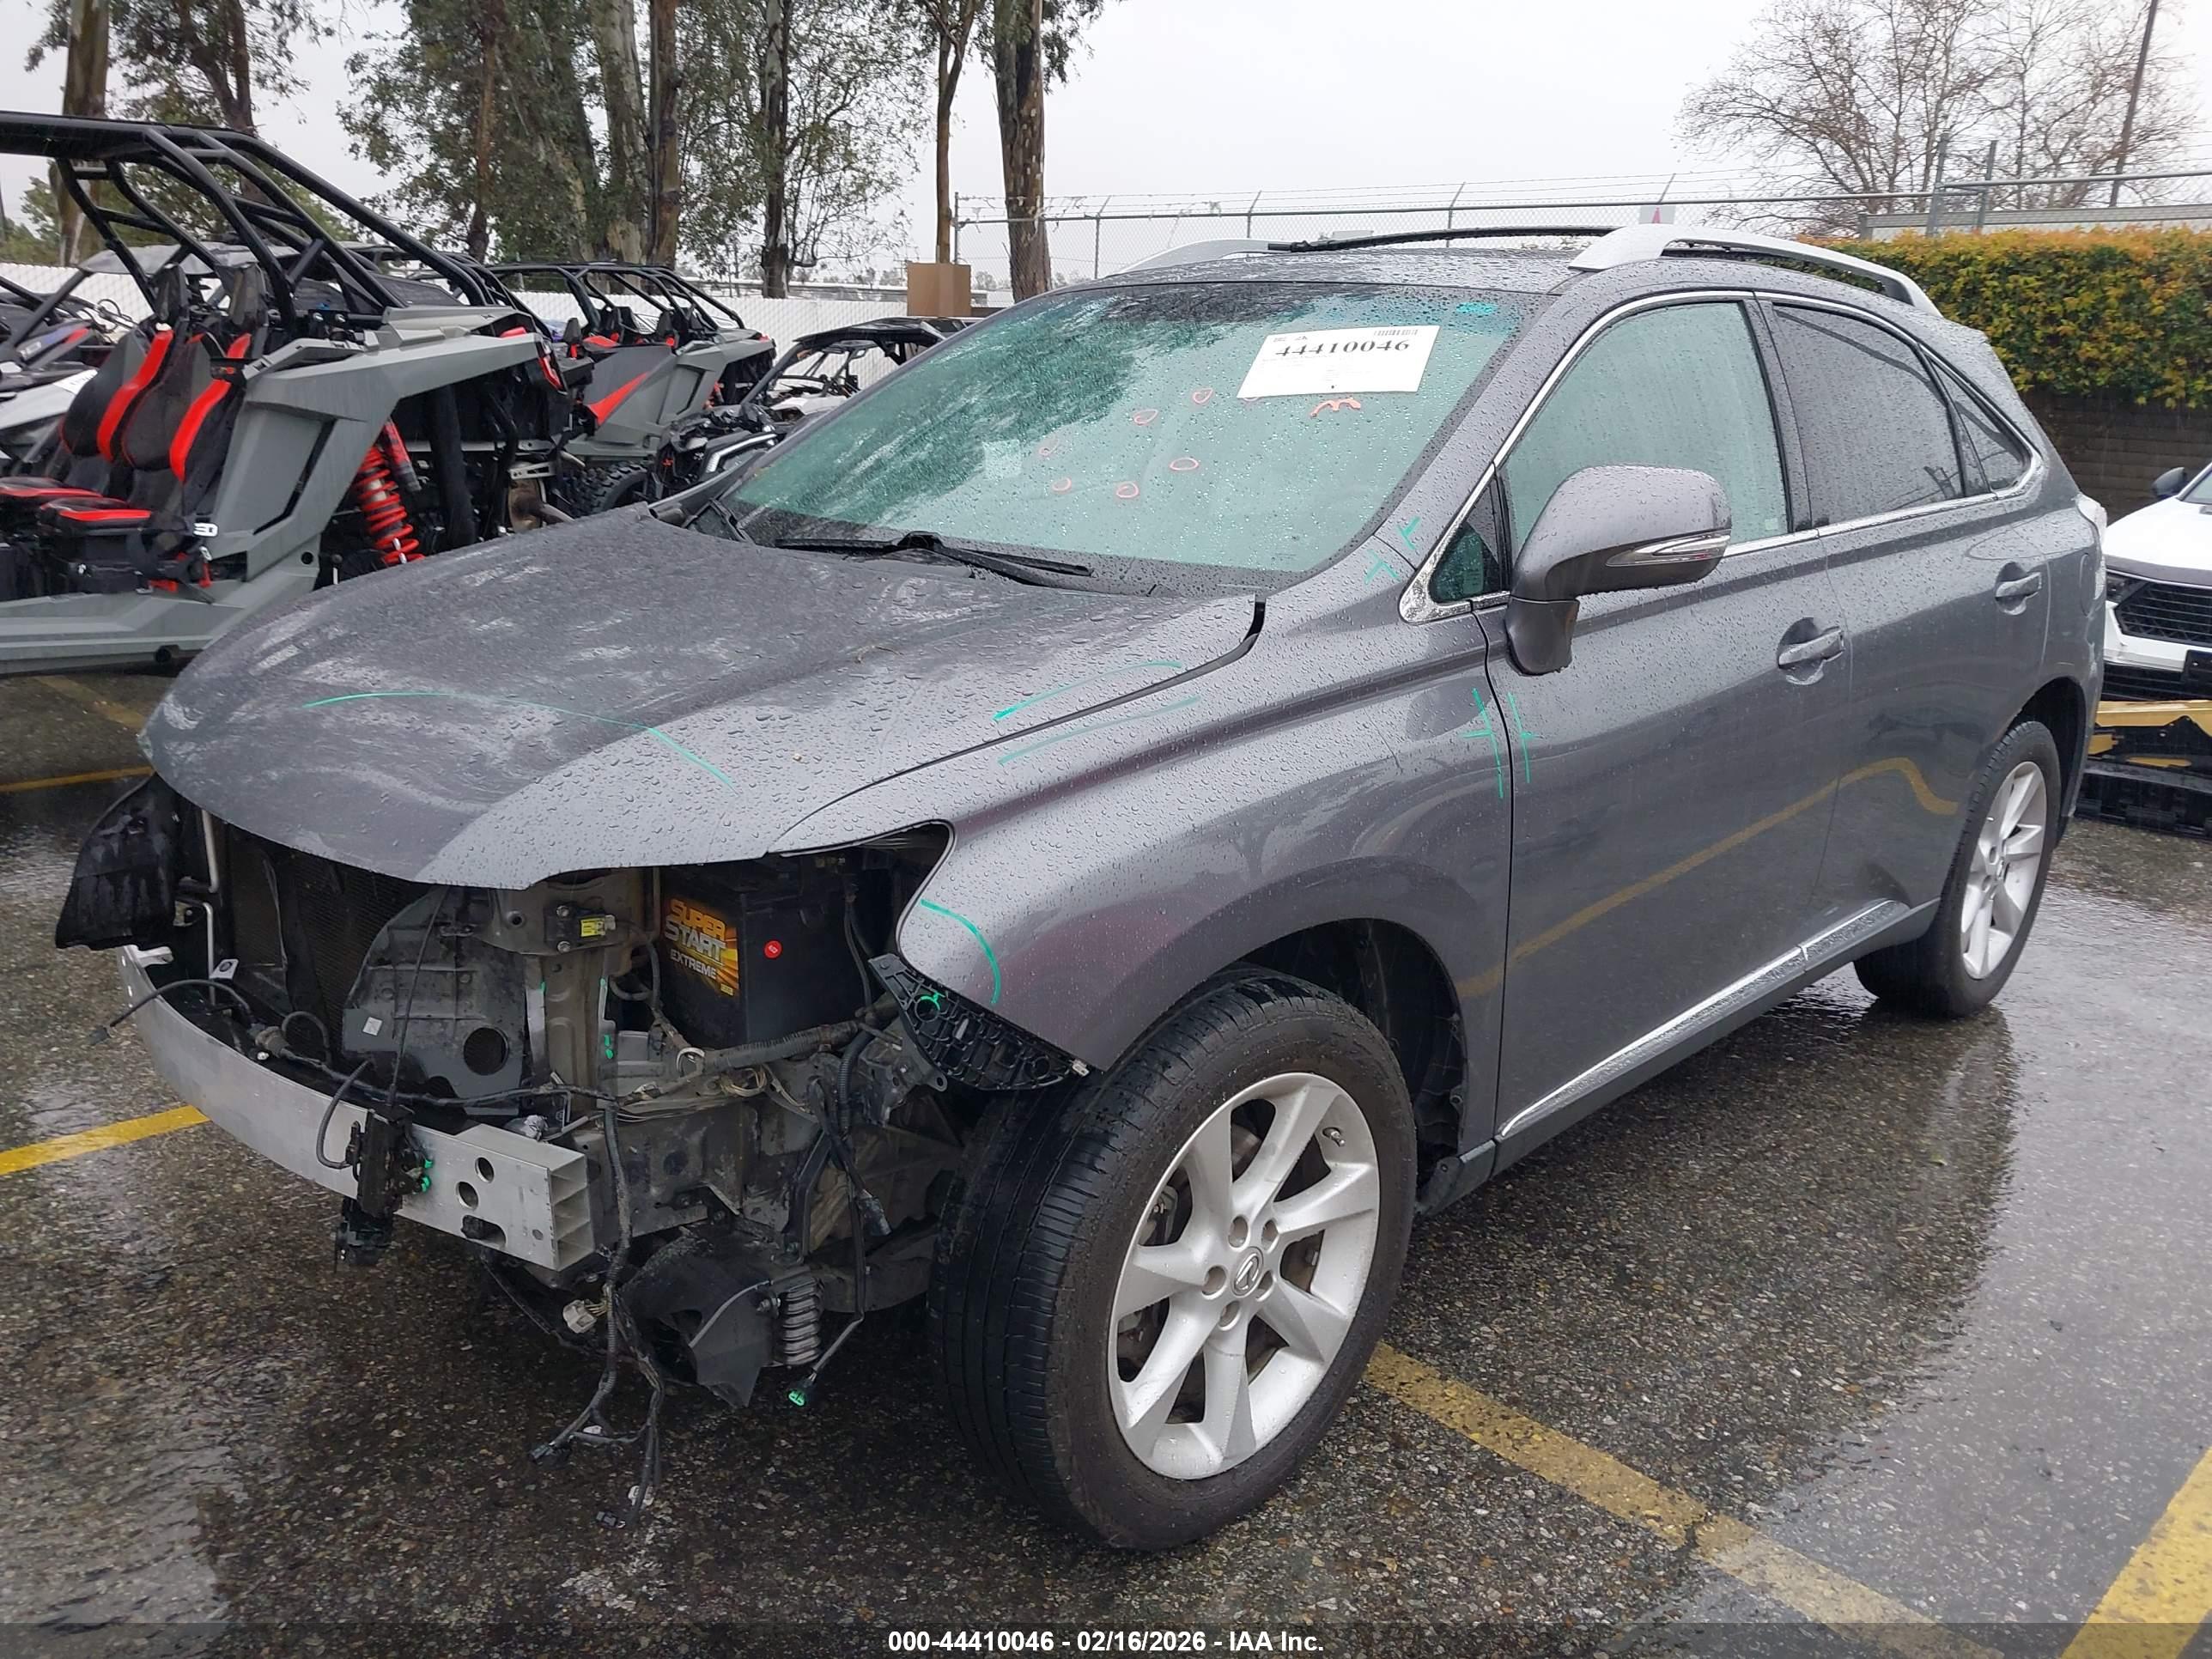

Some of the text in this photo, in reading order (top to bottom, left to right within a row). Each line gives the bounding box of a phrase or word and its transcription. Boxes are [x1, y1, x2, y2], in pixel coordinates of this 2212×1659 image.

[1275, 338, 1410, 357] 44410046
[665, 915, 726, 962] START
[670, 898, 726, 942] SUPER
[670, 948, 718, 981] EXTREME
